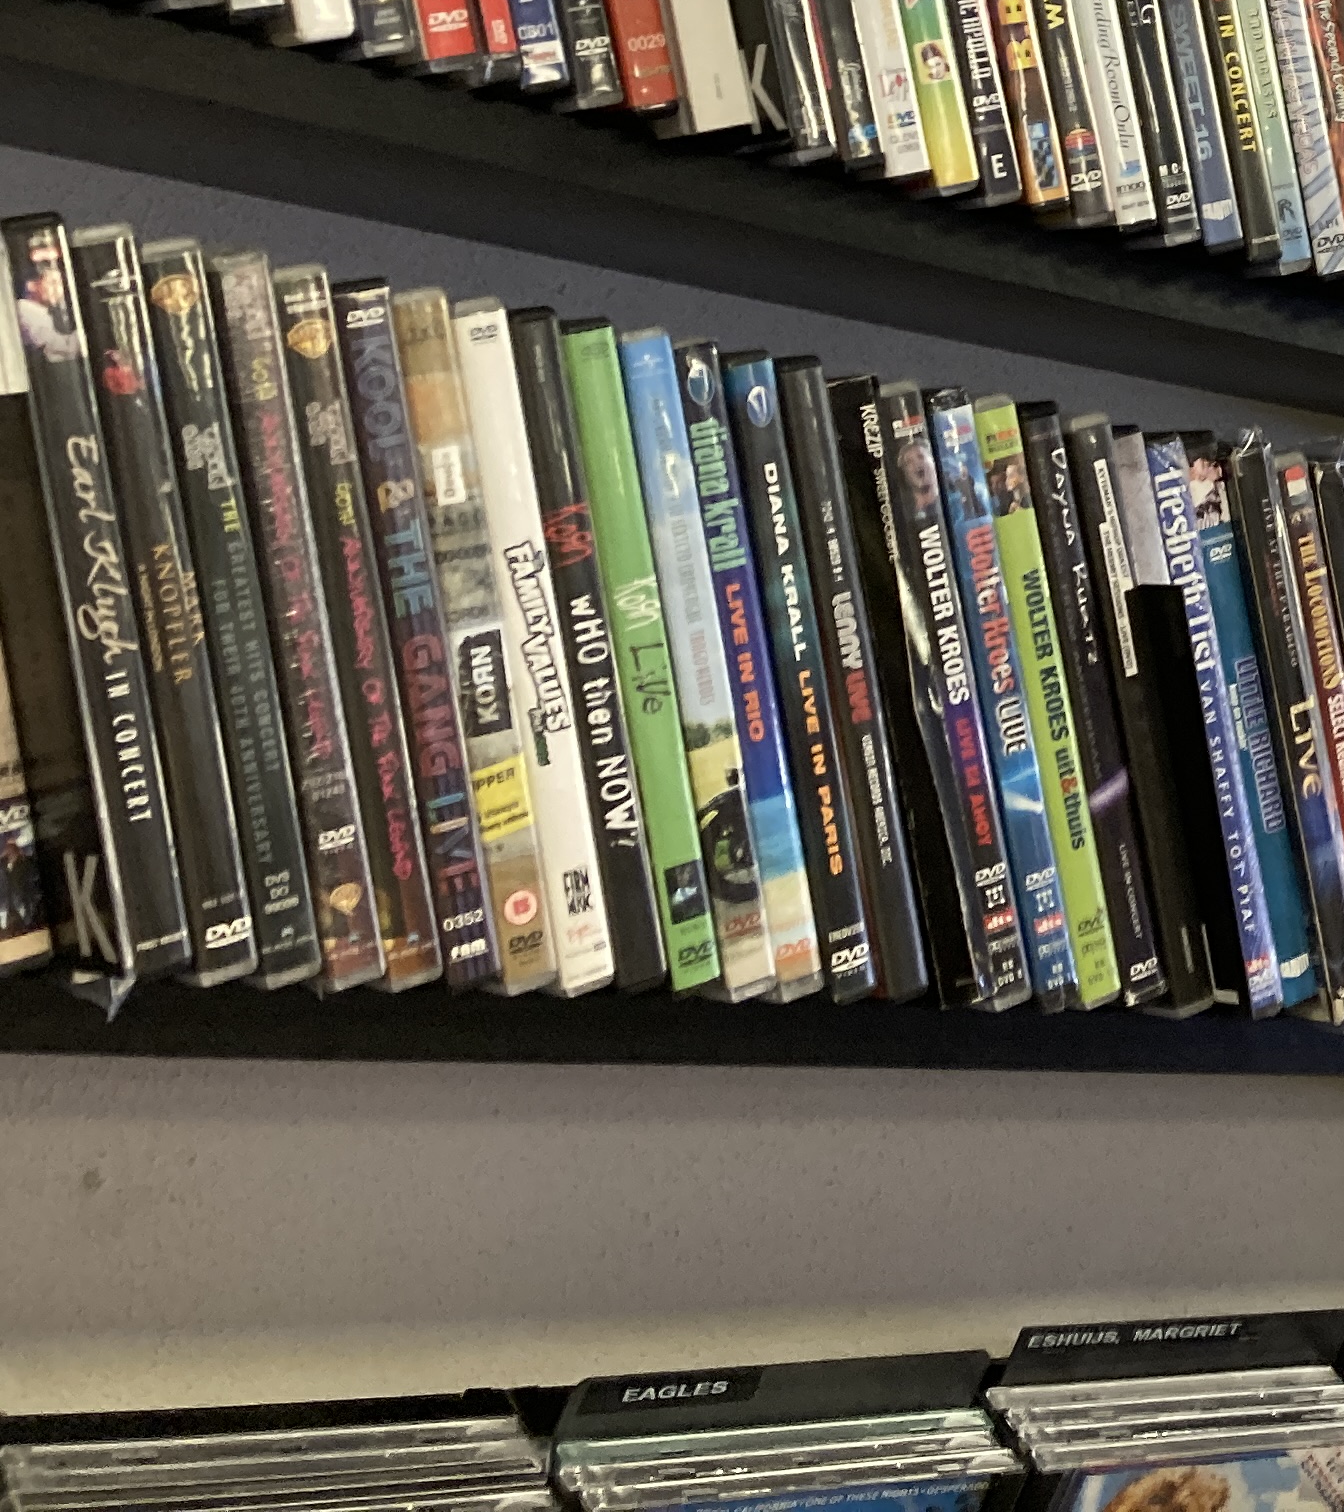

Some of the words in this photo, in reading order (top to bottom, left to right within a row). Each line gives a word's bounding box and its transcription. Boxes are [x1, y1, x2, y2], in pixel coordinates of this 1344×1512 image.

[1216, 13, 1236, 40] IN
[1224, 50, 1258, 154] CONCERT
[351, 336, 406, 461] KOOL
[858, 403, 884, 459] KREZIP
[65, 433, 116, 525] Earl
[690, 417, 729, 497] diana
[1050, 447, 1076, 547] DAYNA
[703, 497, 747, 573] krall
[763, 462, 795, 556] DIANA
[1153, 466, 1204, 608] Liesbeth
[77, 529, 139, 666] Klugh
[383, 519, 434, 621] THE
[153, 543, 195, 685] KNOPFLER
[568, 592, 611, 667] WHO
[725, 582, 748, 647] LIVE
[780, 563, 812, 663] KRALL
[918, 523, 954, 622] WOLTER
[937, 623, 970, 707] KROES
[1020, 568, 1054, 662] WOLTER
[1187, 615, 1218, 672] List
[105, 671, 131, 700] IN
[402, 633, 460, 780] GANG
[469, 644, 501, 726] KORN
[629, 640, 671, 717] Live
[737, 652, 756, 683] IN
[797, 669, 819, 736] LIVE
[1038, 665, 1071, 742] KROES
[1198, 678, 1218, 727] VAN
[1232, 655, 1267, 730] LITTLE
[743, 689, 764, 743] RIO
[111, 711, 153, 824] CONCERT
[809, 743, 827, 777] IN
[1054, 743, 1087, 851] uit&thuis
[1208, 735, 1236, 819] SHAFFY
[1243, 728, 1287, 835] RICHARD
[817, 785, 844, 879] PARIS
[1227, 830, 1246, 875] TOT
[63, 851, 118, 964] K
[1235, 885, 1256, 936] PIAF
[1028, 1328, 1121, 1350] ESHUIJS,
[1133, 1322, 1242, 1343] MARGRIET
[621, 1380, 730, 1404] EAGLES
